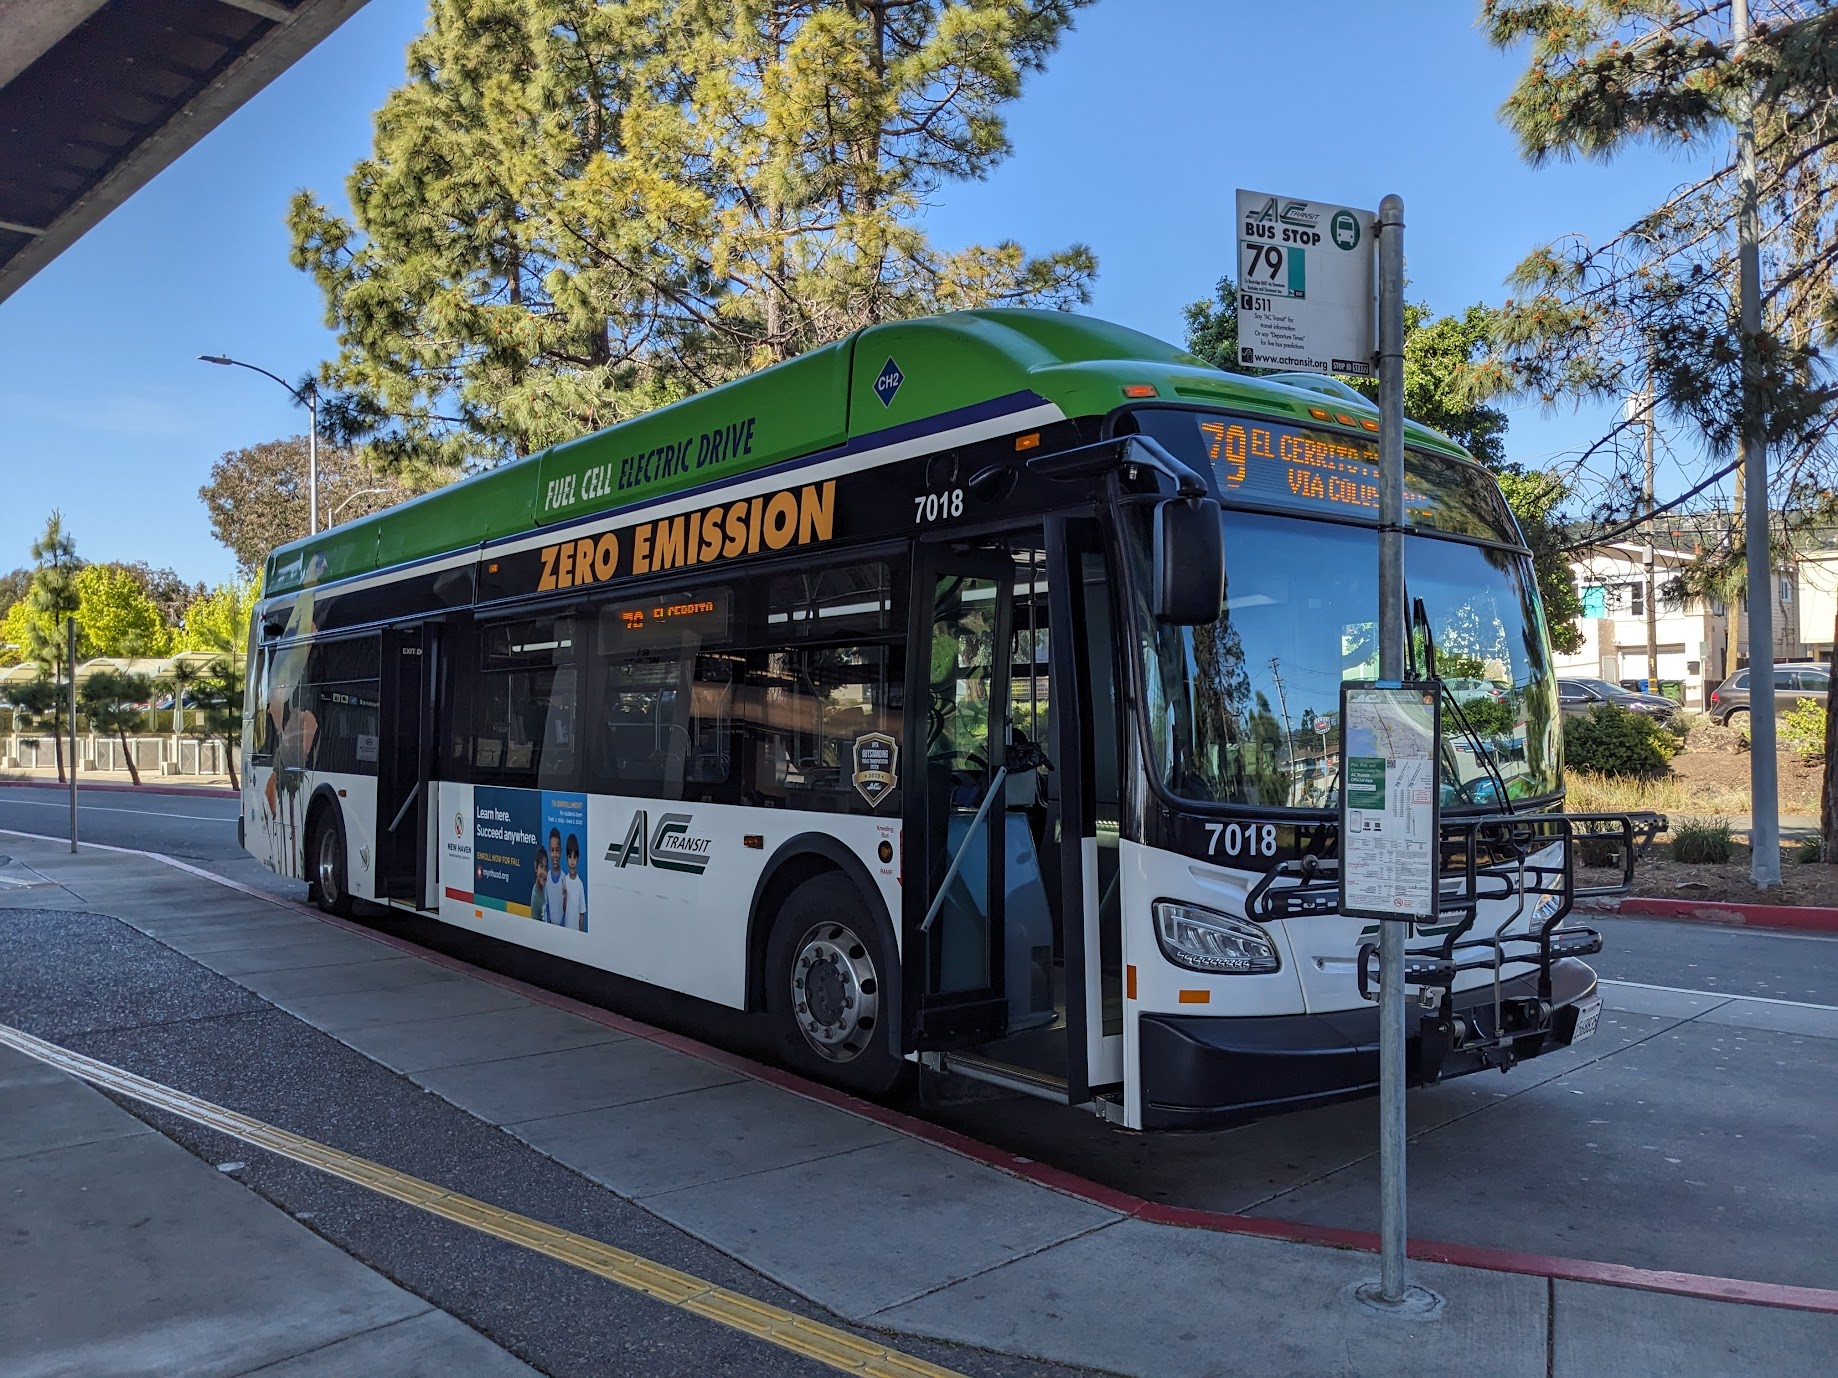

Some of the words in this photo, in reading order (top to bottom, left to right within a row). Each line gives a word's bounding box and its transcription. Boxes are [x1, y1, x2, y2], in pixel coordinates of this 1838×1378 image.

[1246, 198, 1319, 228] AC
[1289, 210, 1320, 220] TRANSIT
[1246, 222, 1276, 240] BUS
[1282, 228, 1320, 246] STOP
[1246, 243, 1283, 281] 79
[1254, 298, 1271, 312] 511
[1254, 353, 1328, 371] www.actransit.org
[1333, 362, 1345, 370] STOP
[877, 372, 899, 391] CH2
[544, 478, 577, 511] FUEL
[581, 463, 613, 501] CELL
[618, 438, 692, 490] ELECTRIC
[696, 417, 756, 468] DRIVE
[1202, 422, 1246, 488] 79
[1252, 429, 1275, 458] EL
[1280, 434, 1359, 474] CERRITO
[1288, 468, 1324, 499] VIA
[914, 489, 964, 524] 7018
[537, 532, 619, 592] ZERO
[632, 480, 836, 576] EMISSION
[862, 750, 888, 758] OUTSTANDING
[476, 806, 494, 820] Learn
[495, 807, 510, 822] here.
[477, 824, 503, 840] Succeed
[504, 829, 537, 845] anywhere.
[877, 825, 894, 833] Kneeling
[448, 843, 456, 851] NEW
[458, 845, 471, 854] HAVEN
[604, 810, 710, 875] AC
[666, 836, 712, 853] TRANSIT
[1205, 823, 1276, 856] 7018
[477, 852, 492, 862] ENROLL
[492, 854, 501, 863] NOW
[502, 856, 510, 864] FOR
[511, 857, 520, 867] FALL
